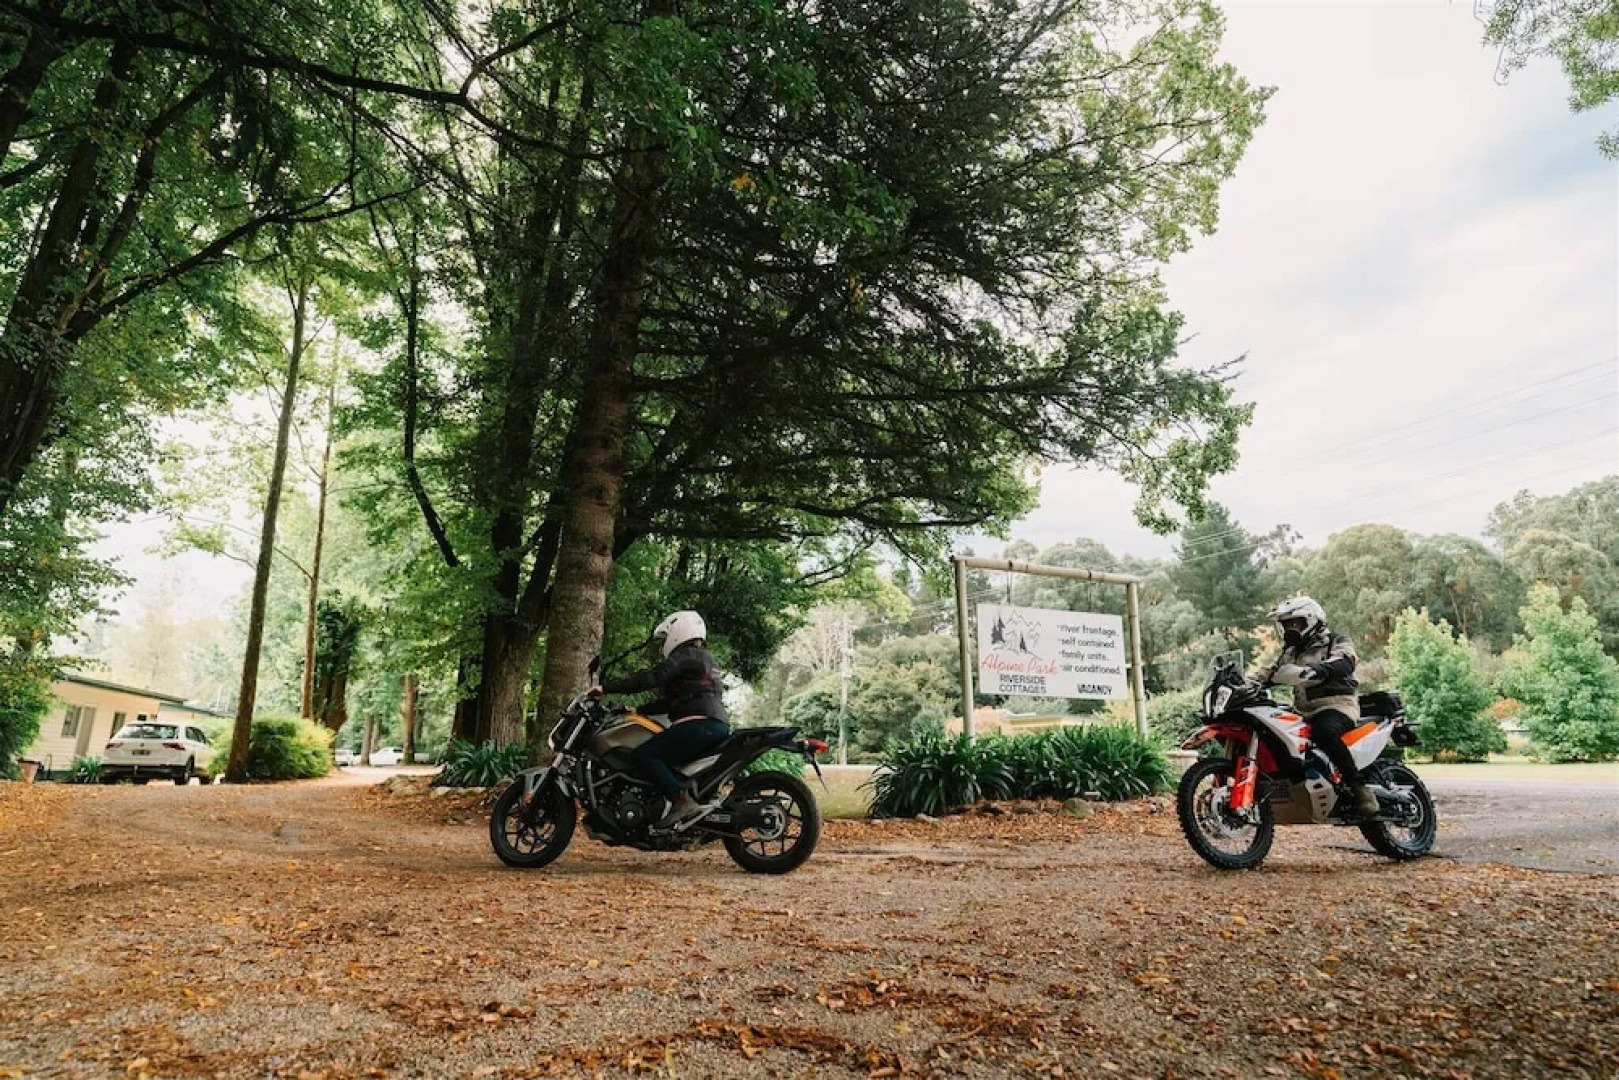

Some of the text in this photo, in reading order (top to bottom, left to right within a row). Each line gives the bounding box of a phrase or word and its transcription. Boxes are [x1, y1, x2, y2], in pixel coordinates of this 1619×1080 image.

[1062, 637, 1075, 645] self
[1062, 649, 1085, 661] family
[981, 653, 1059, 675] Alpine Park
[1000, 675, 1046, 685] RIVERSIDE
[999, 685, 1047, 693] COTTAGES
[1077, 684, 1112, 695] VACANCY
